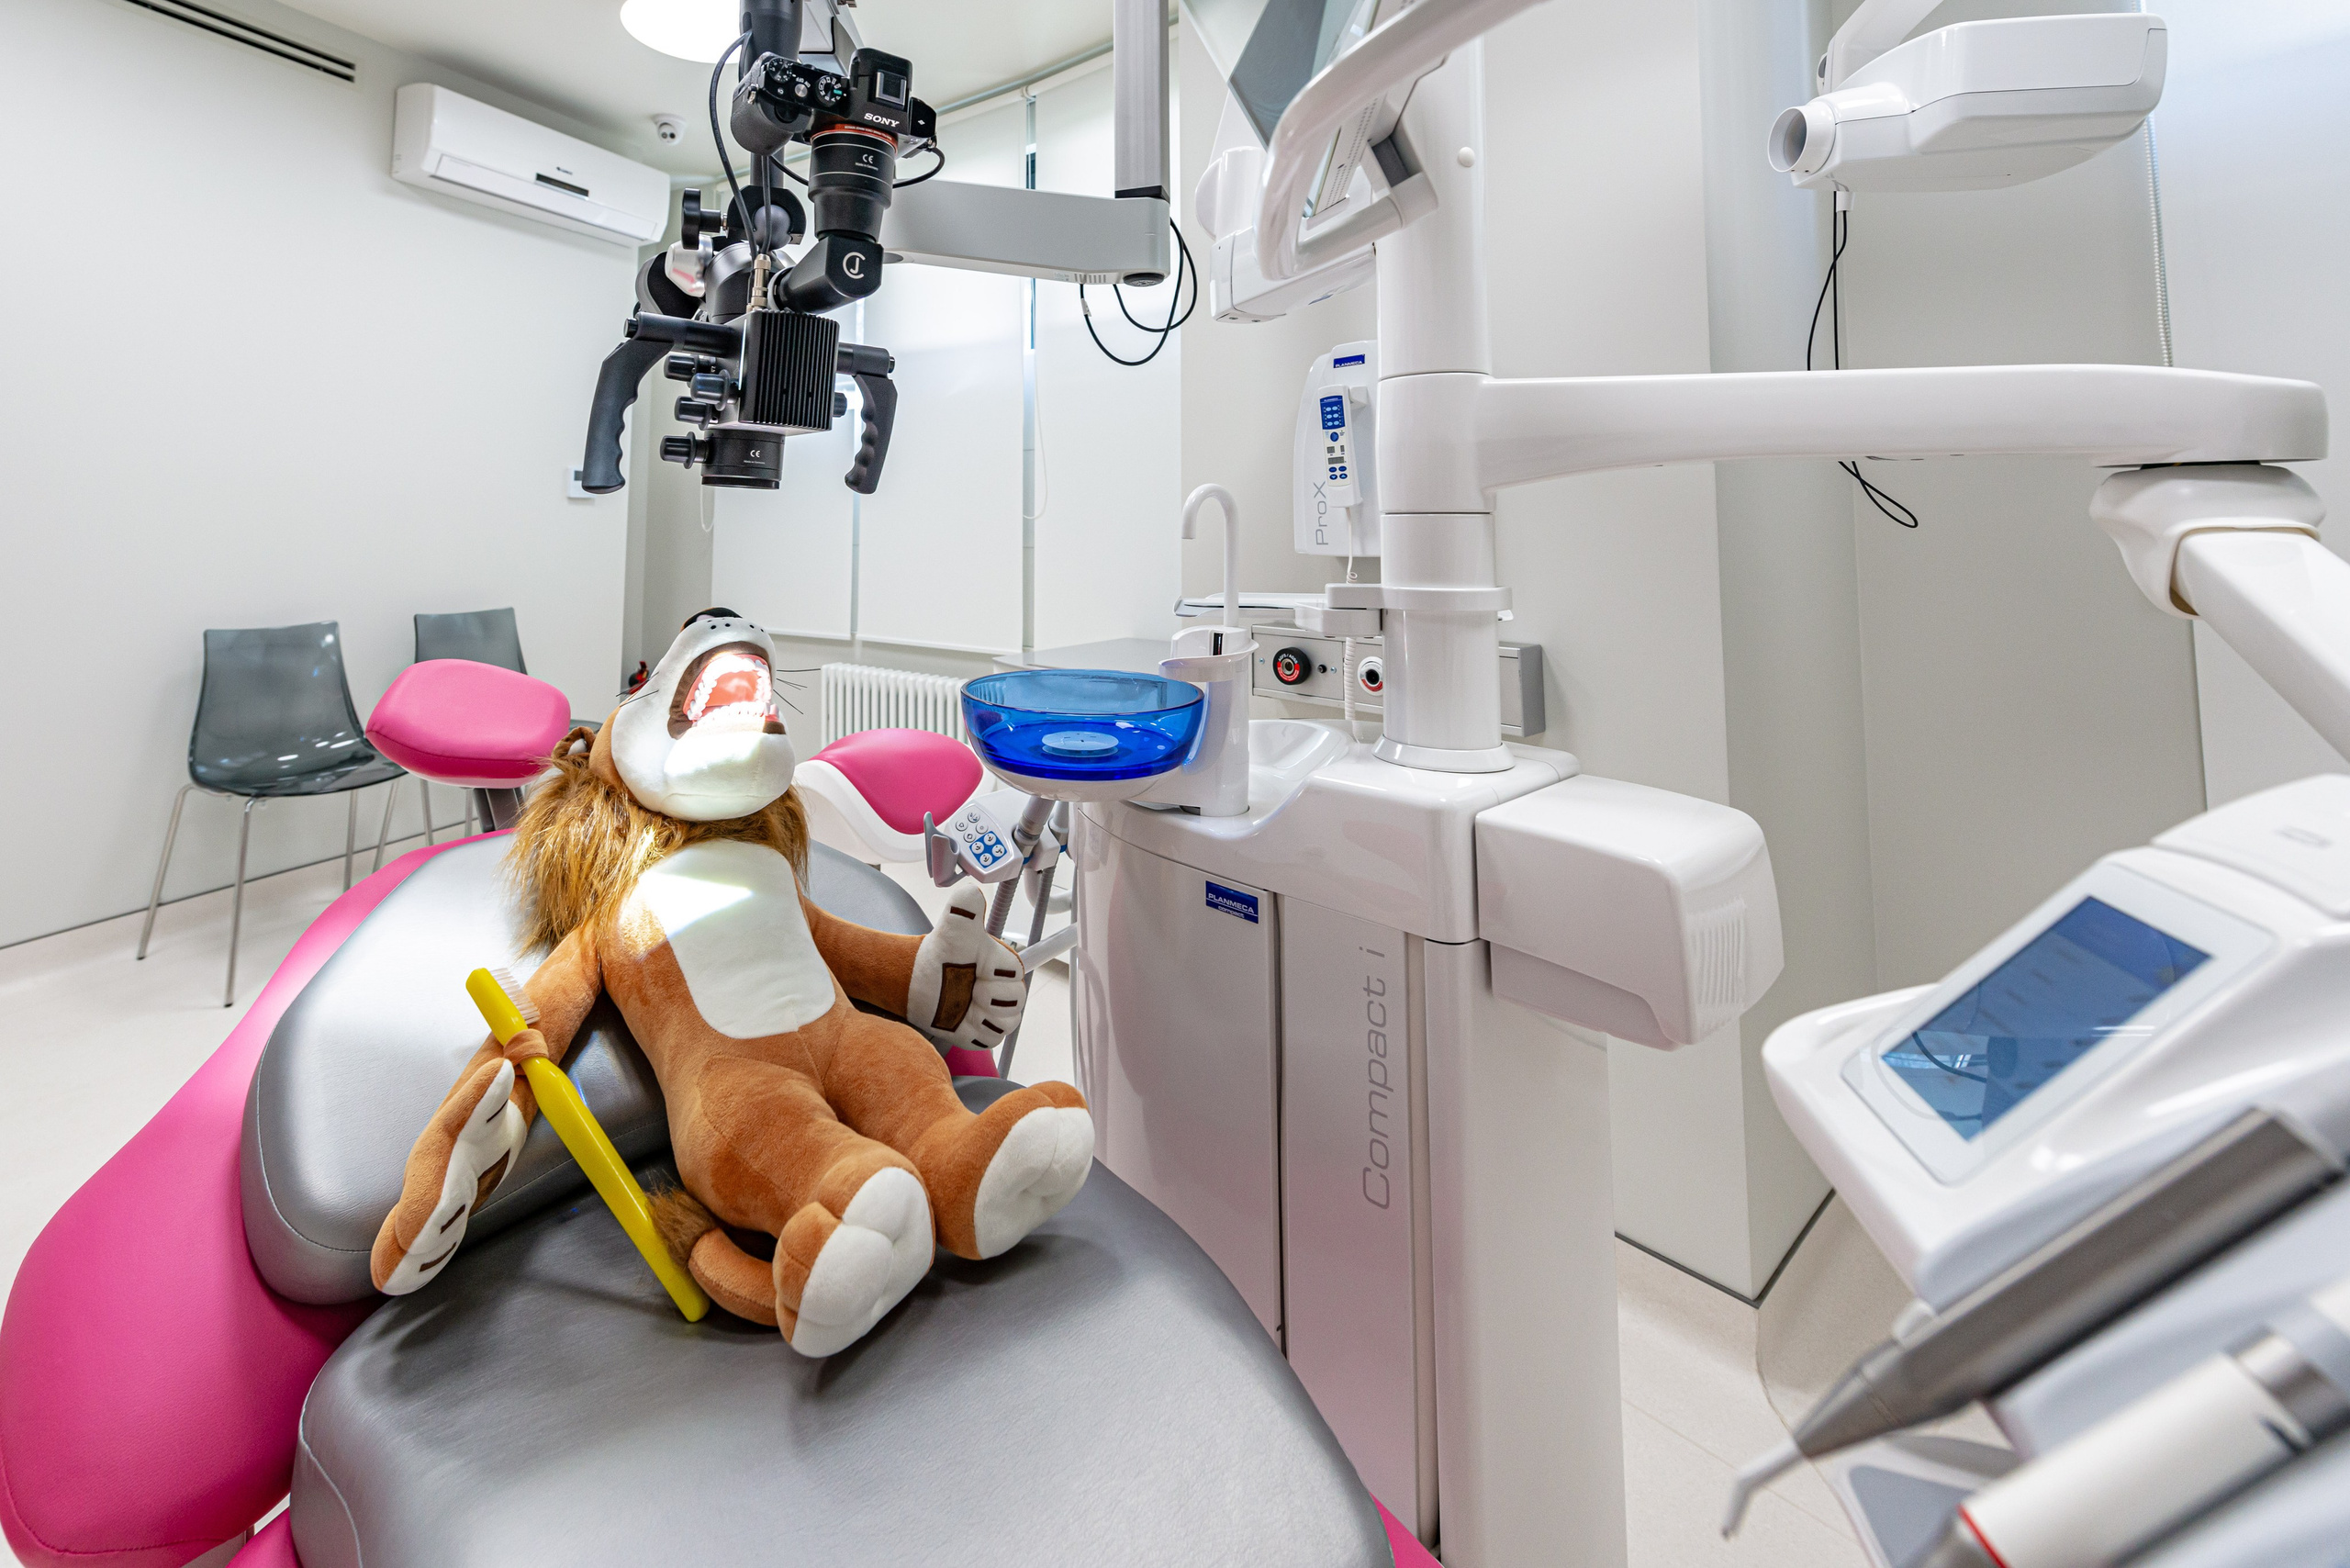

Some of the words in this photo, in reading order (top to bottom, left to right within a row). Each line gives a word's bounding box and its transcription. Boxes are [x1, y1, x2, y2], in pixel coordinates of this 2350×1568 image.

[864, 112, 900, 128] SONY
[862, 153, 874, 164] CE
[1313, 480, 1328, 545] ProX
[1208, 892, 1255, 914] PLANMECA
[1217, 905, 1245, 919] compact
[1362, 975, 1393, 1210] Compact
